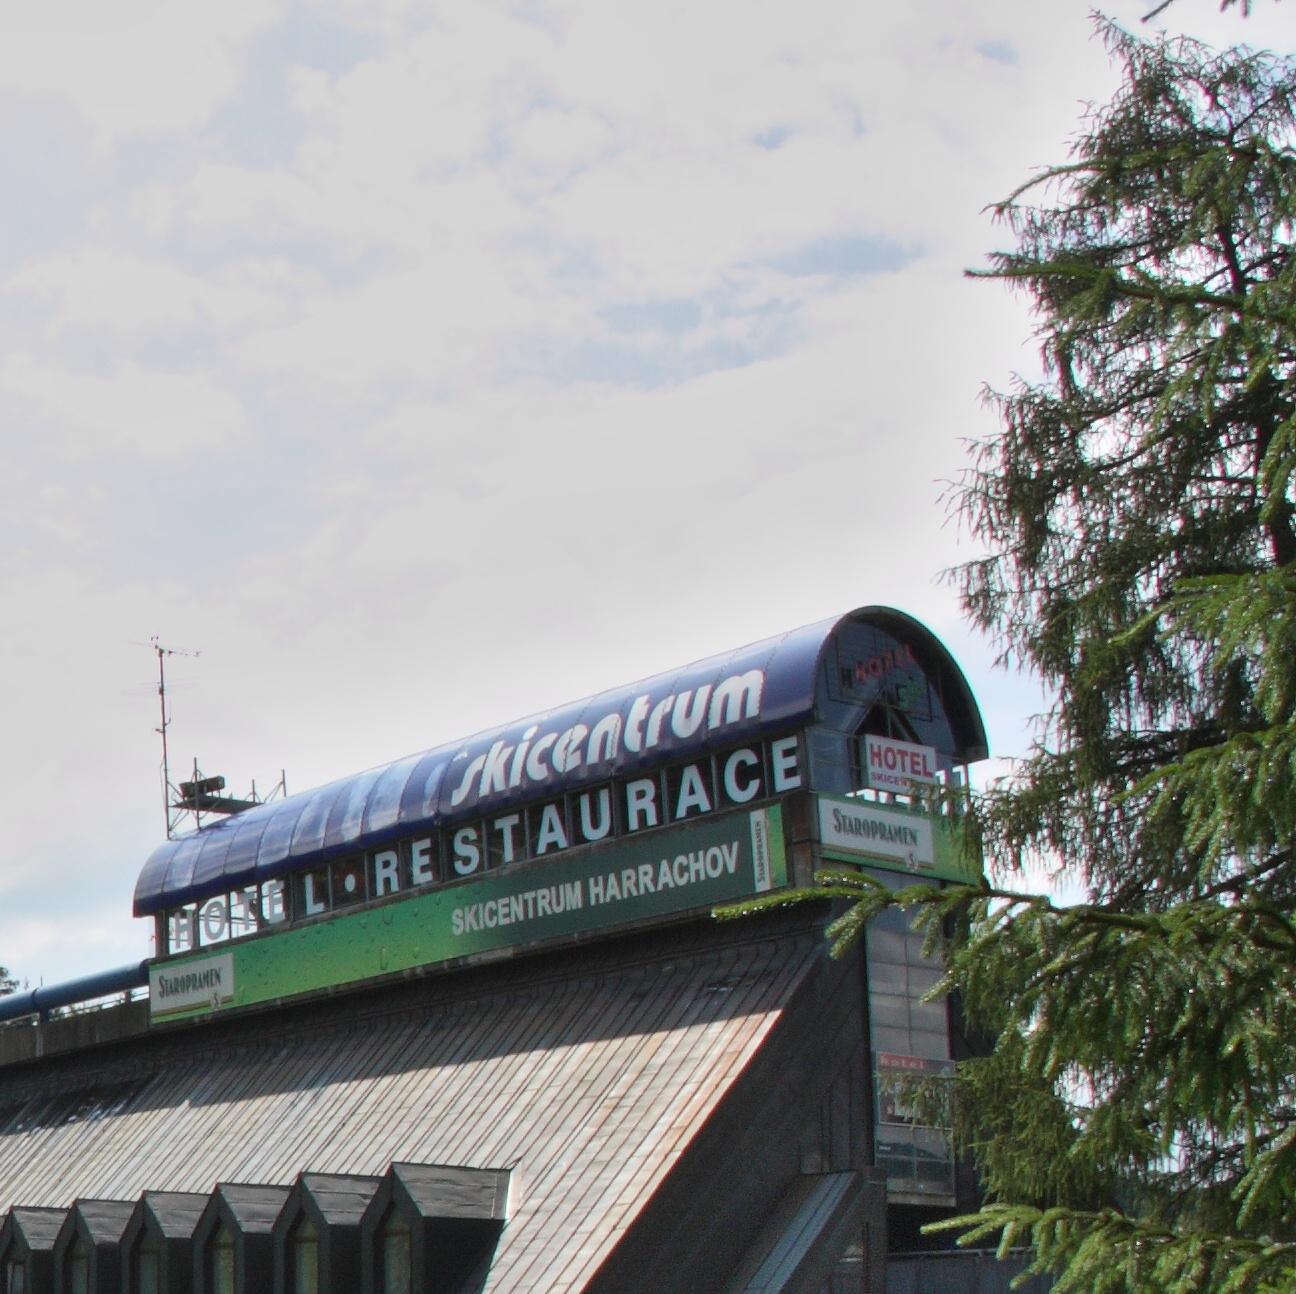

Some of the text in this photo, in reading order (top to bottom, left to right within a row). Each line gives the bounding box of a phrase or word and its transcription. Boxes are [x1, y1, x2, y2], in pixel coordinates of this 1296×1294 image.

[450, 669, 766, 807] skicentrum
[870, 744, 933, 778] HOTEL
[175, 735, 802, 949] HOTEL RESTAURACE
[832, 807, 920, 846] STAROPRAMEN
[451, 841, 740, 934] SKICENTRUM HARRACHOV
[158, 967, 222, 998] STAROPRAMEN
